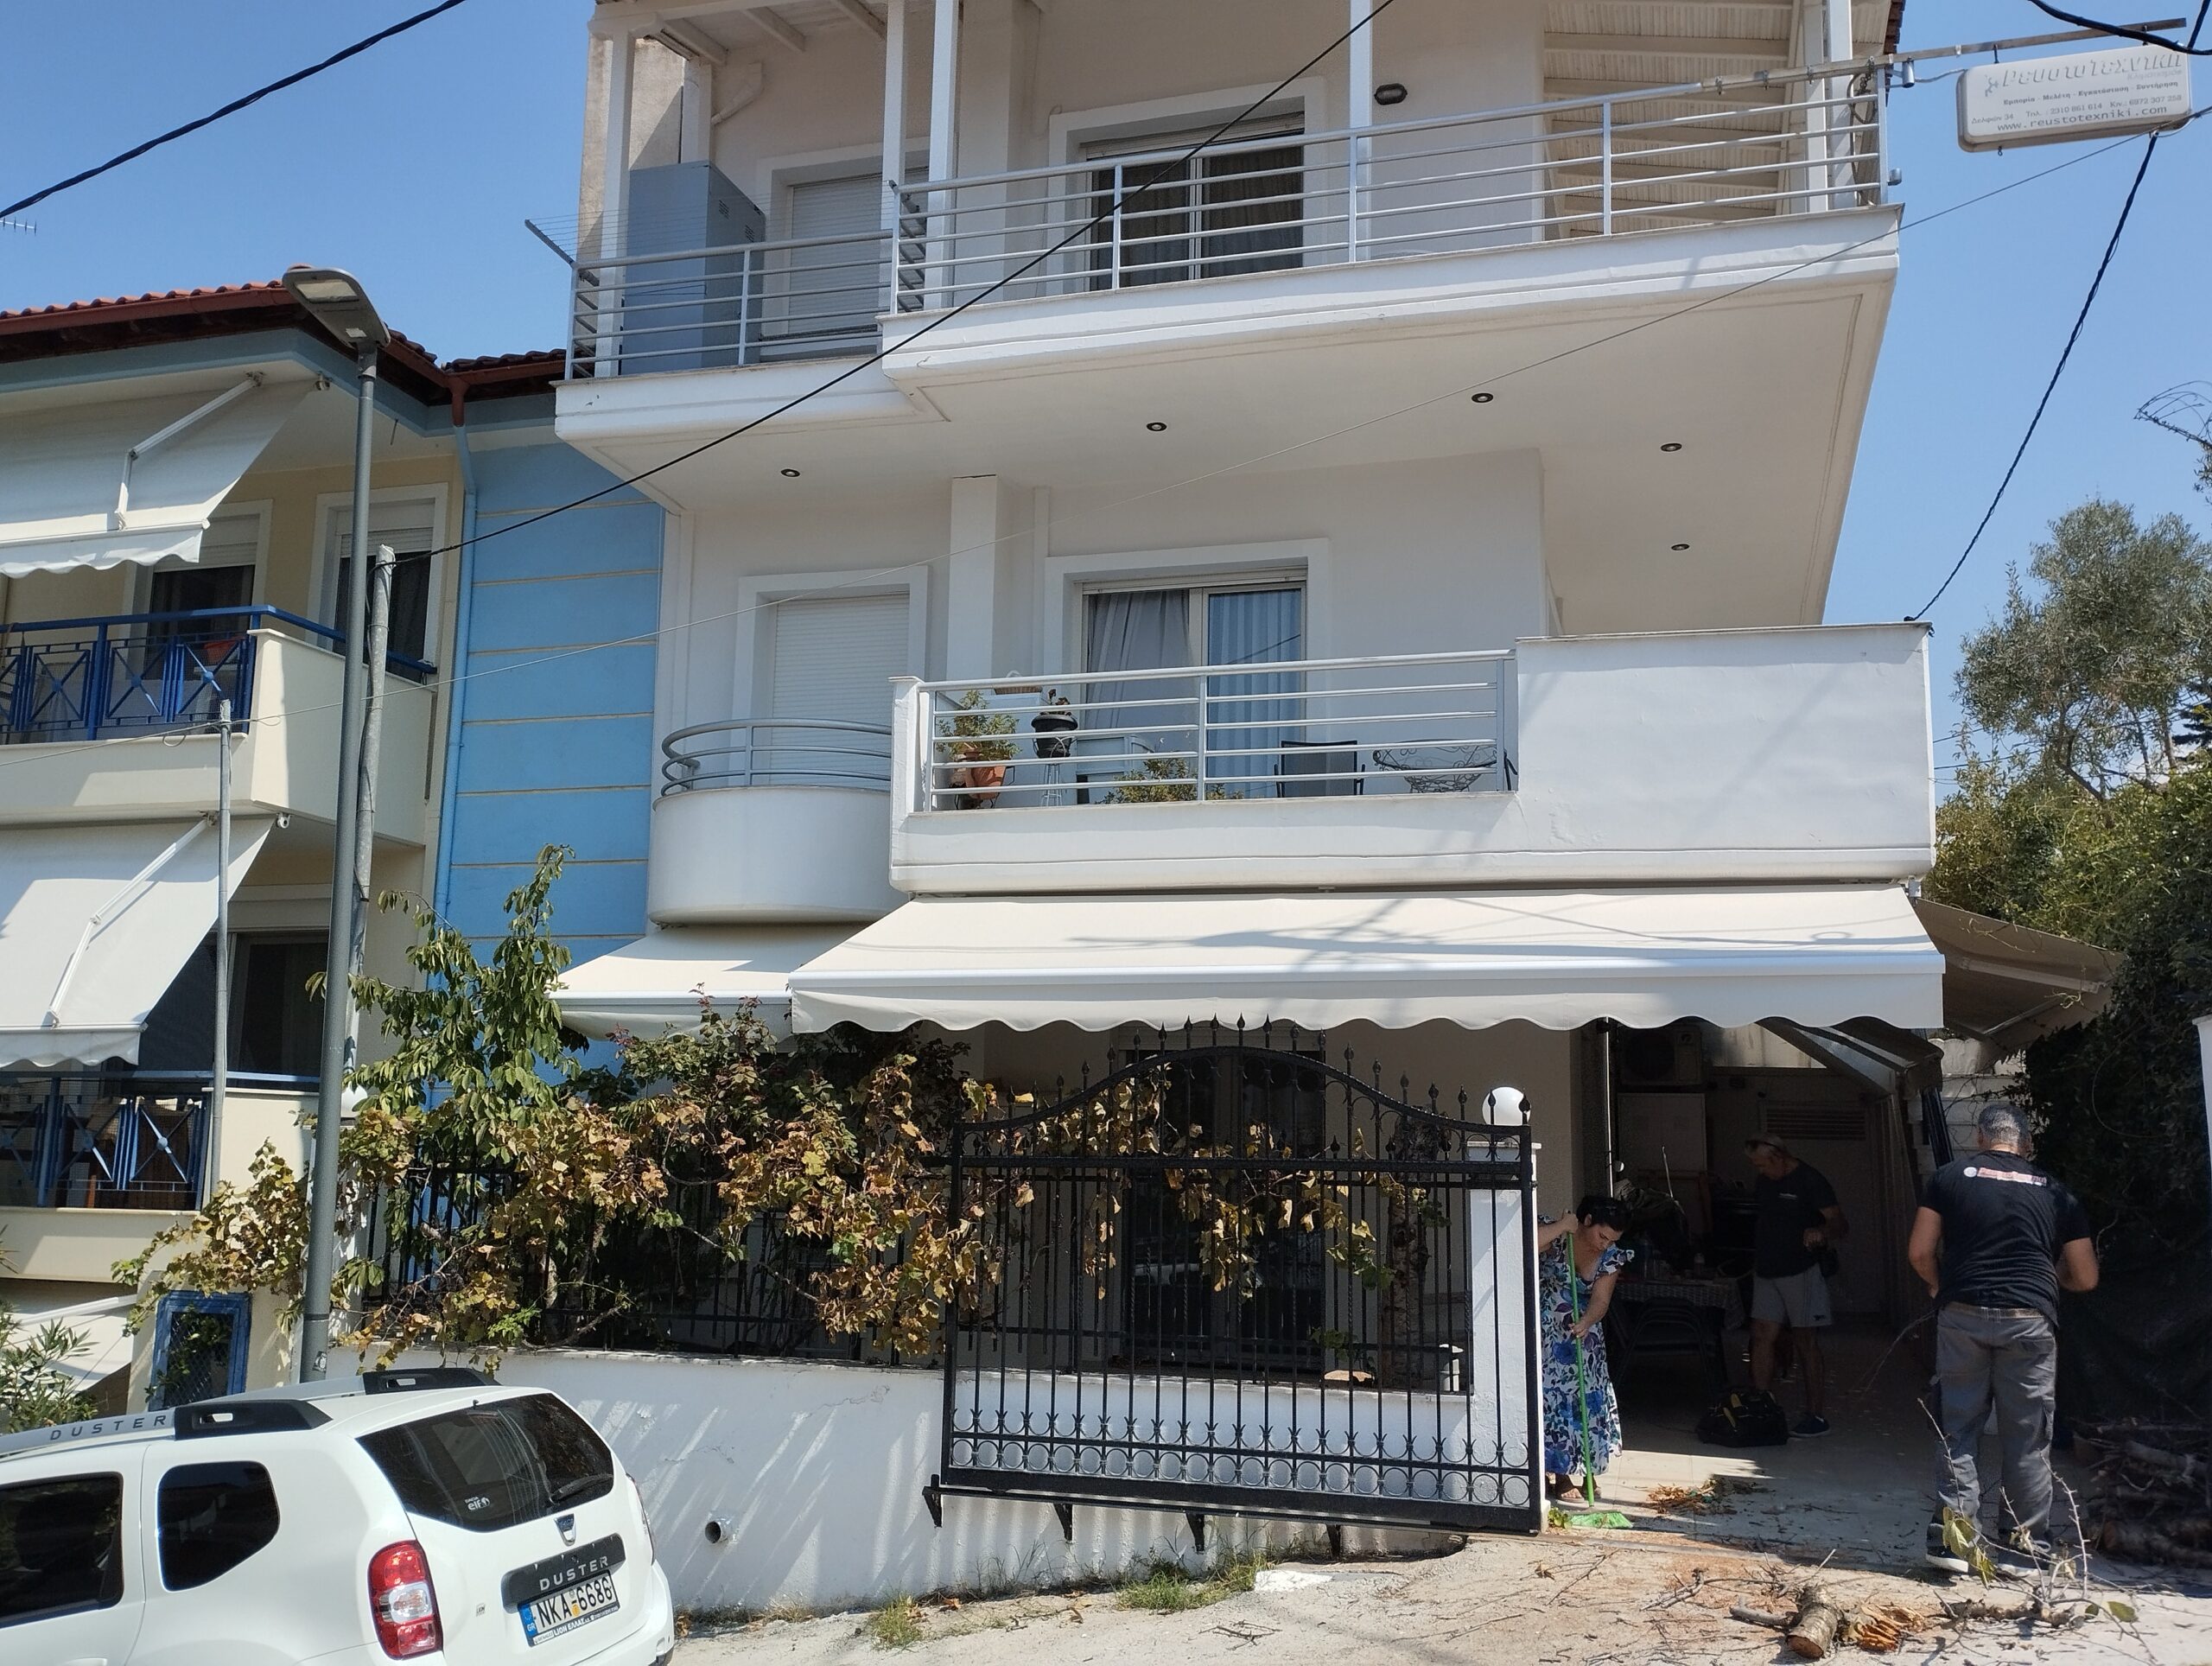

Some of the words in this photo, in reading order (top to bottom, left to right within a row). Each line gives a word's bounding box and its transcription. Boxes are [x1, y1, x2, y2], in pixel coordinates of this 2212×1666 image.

[2050, 106, 2069, 115] 2310
[1997, 105, 2167, 130] www.reustotexniki.com
[50, 1415, 167, 1440] DUSTER
[467, 1499, 481, 1510] elf
[539, 1555, 609, 1591] DUSTER
[526, 1623, 537, 1632] GR
[553, 1624, 569, 1636] LION
